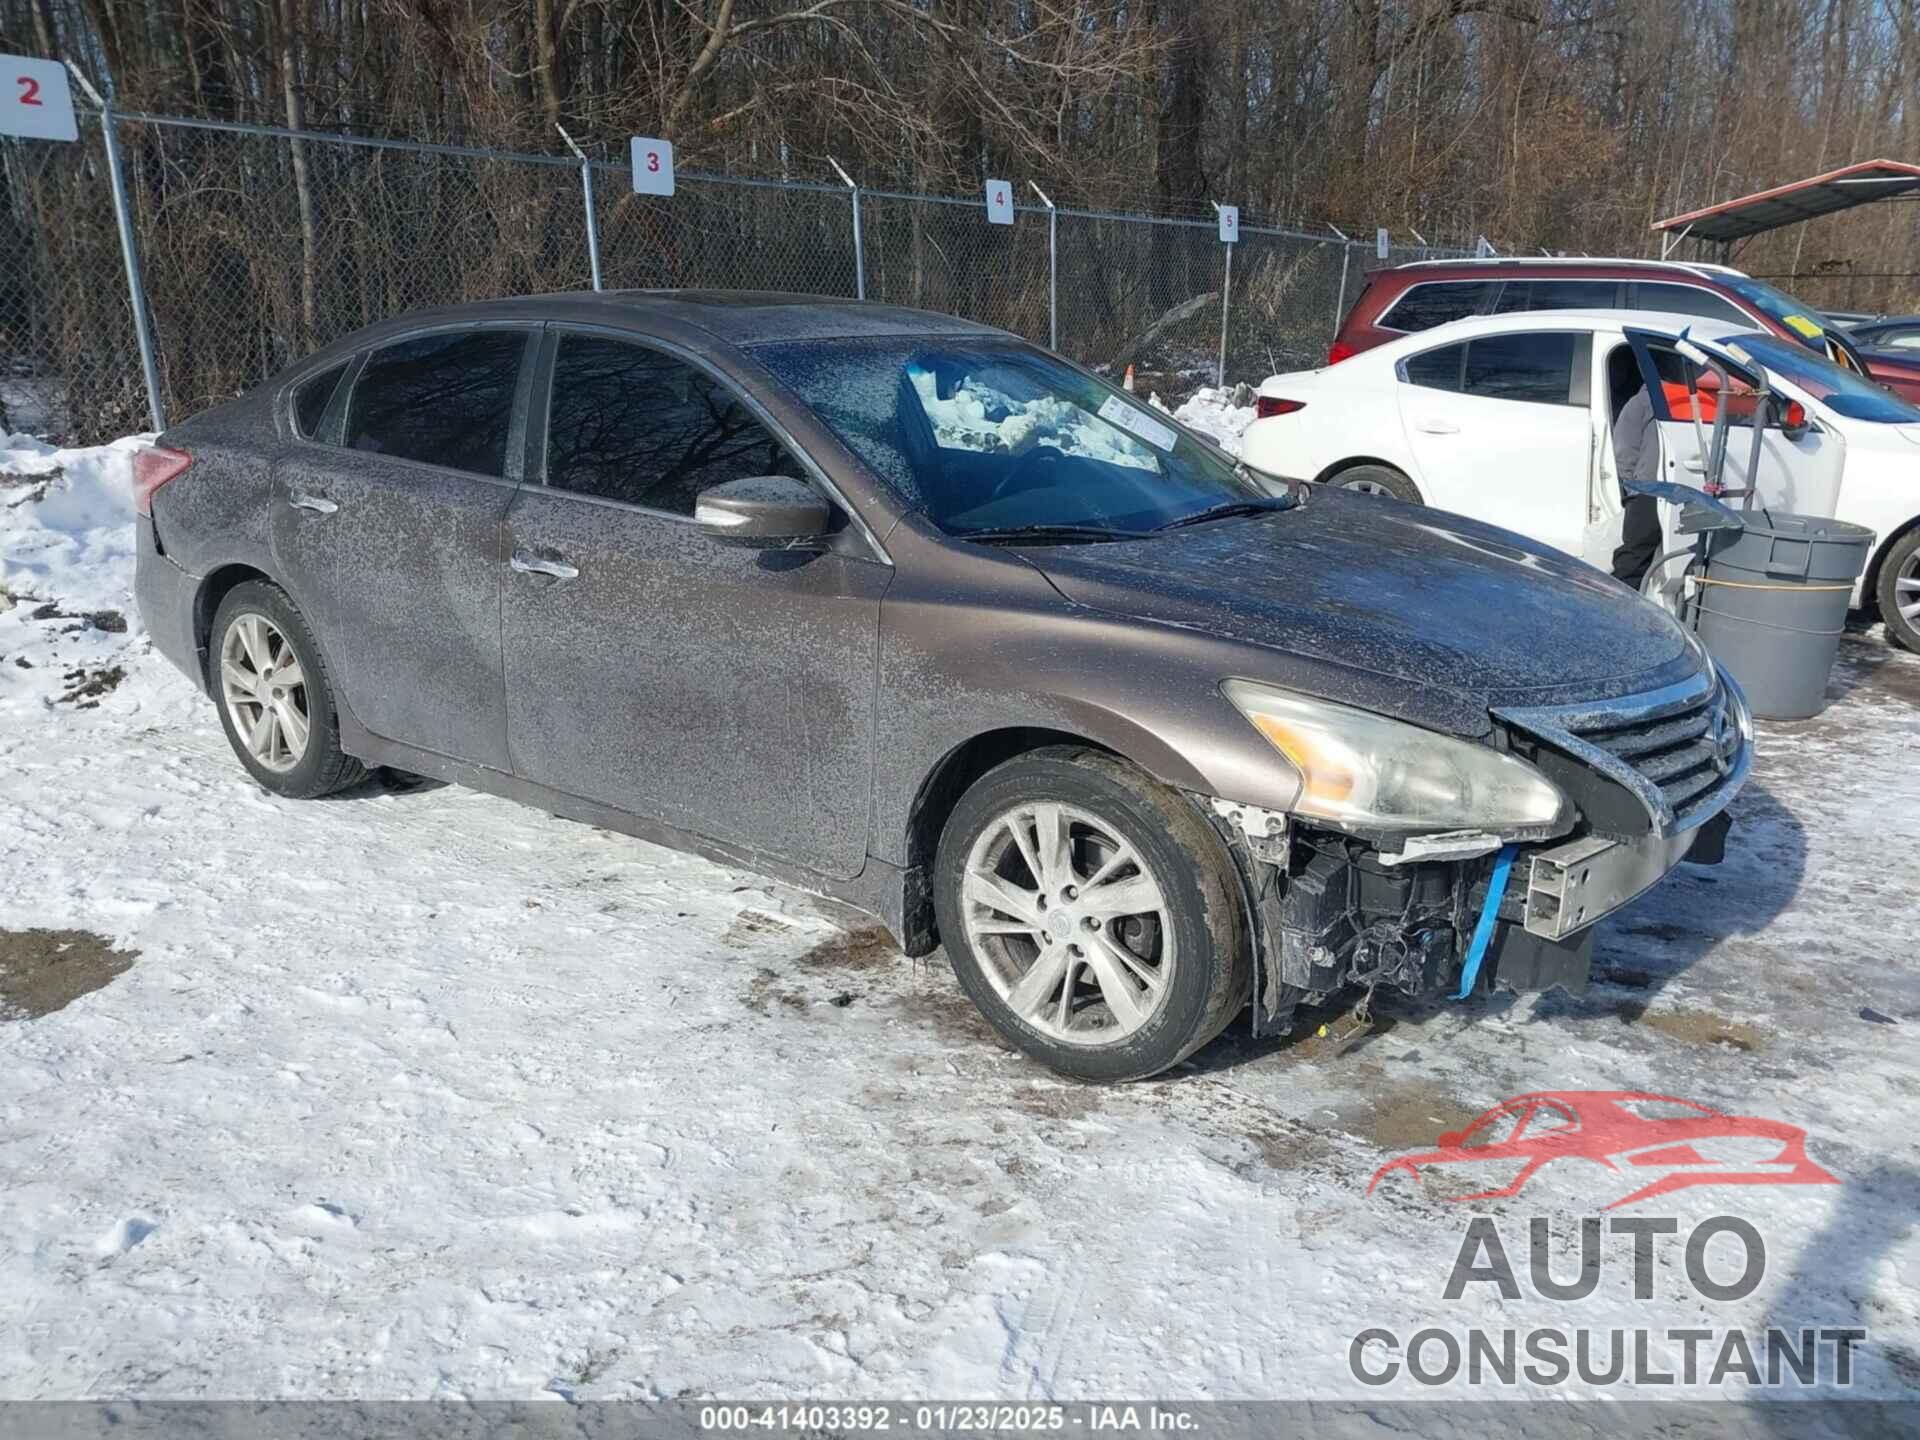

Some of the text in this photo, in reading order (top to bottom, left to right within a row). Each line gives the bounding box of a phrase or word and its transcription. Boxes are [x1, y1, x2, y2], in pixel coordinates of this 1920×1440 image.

[17, 76, 43, 106] 2
[647, 151, 659, 172] 3
[995, 191, 1004, 207] 4
[1226, 214, 1233, 227] 5
